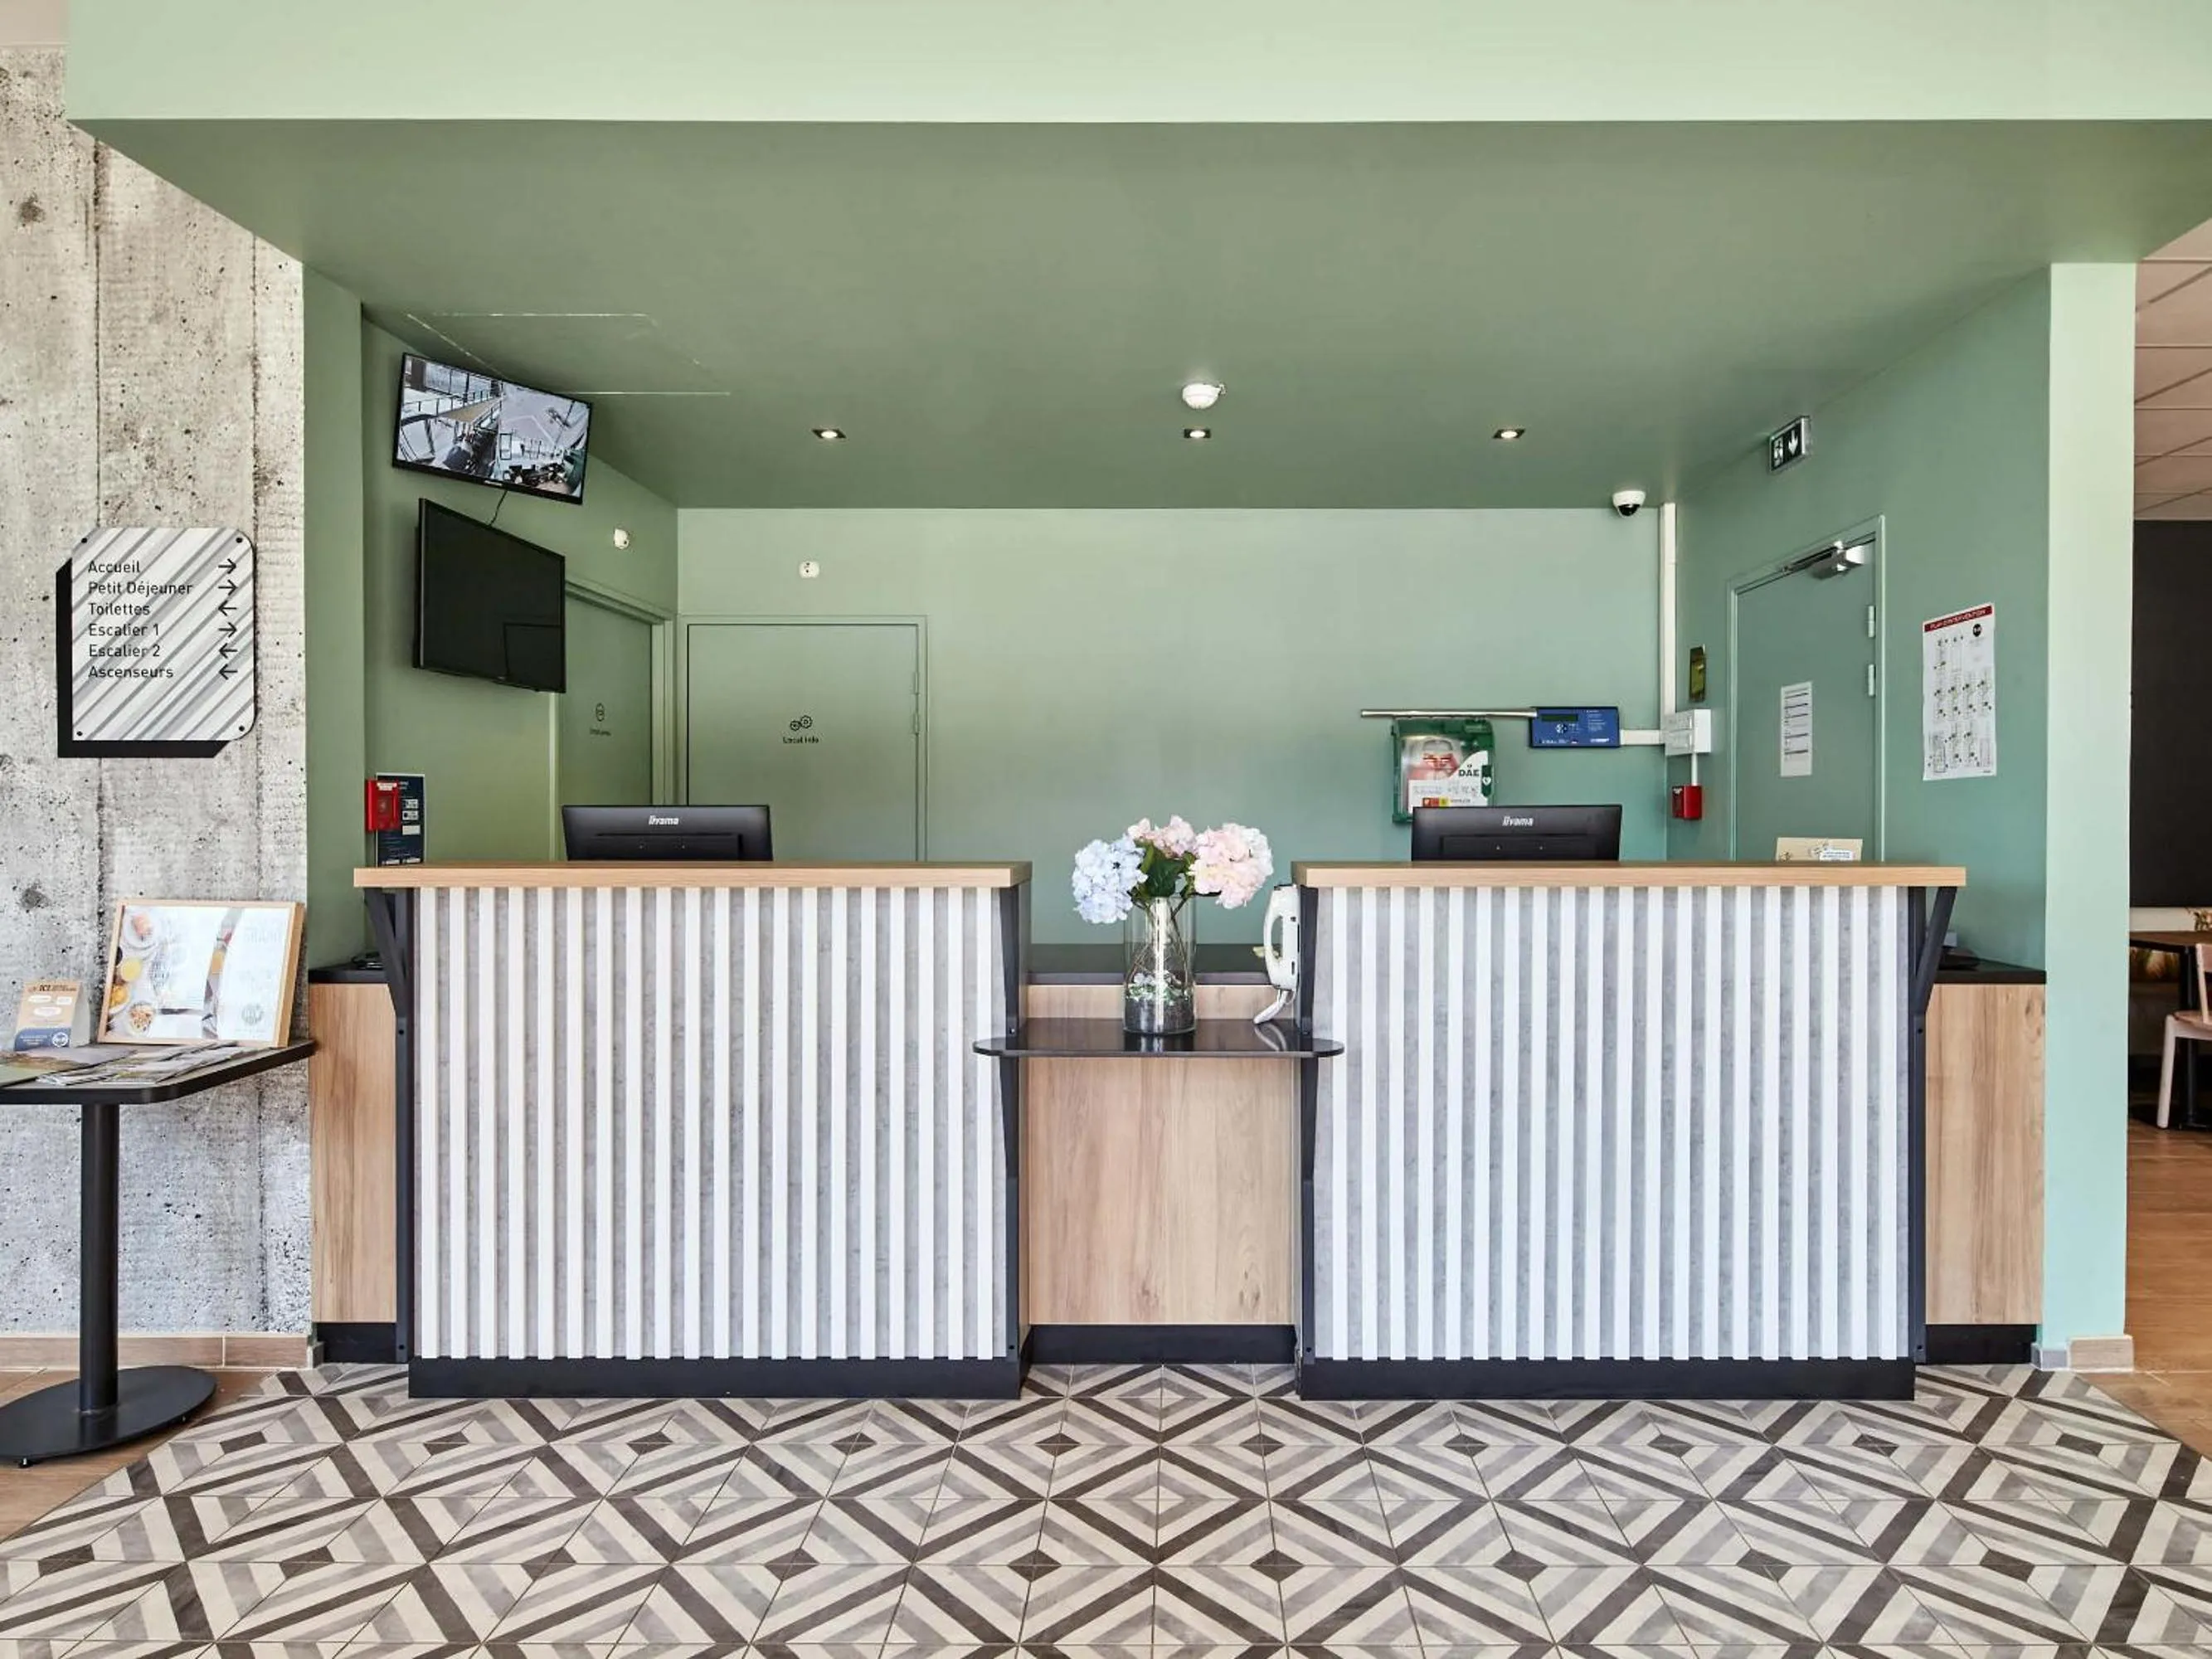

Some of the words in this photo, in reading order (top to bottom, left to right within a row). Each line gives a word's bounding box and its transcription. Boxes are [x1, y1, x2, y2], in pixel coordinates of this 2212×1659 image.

[88, 560, 141, 573] Accueil
[88, 581, 122, 595] Petit
[127, 581, 193, 597] Déjeuner
[88, 602, 150, 615] Toilettes
[89, 623, 148, 636] Escalier
[153, 624, 160, 636] 1
[89, 644, 148, 657] Escalier
[153, 645, 161, 657] 2
[88, 665, 173, 679] Ascenseurs
